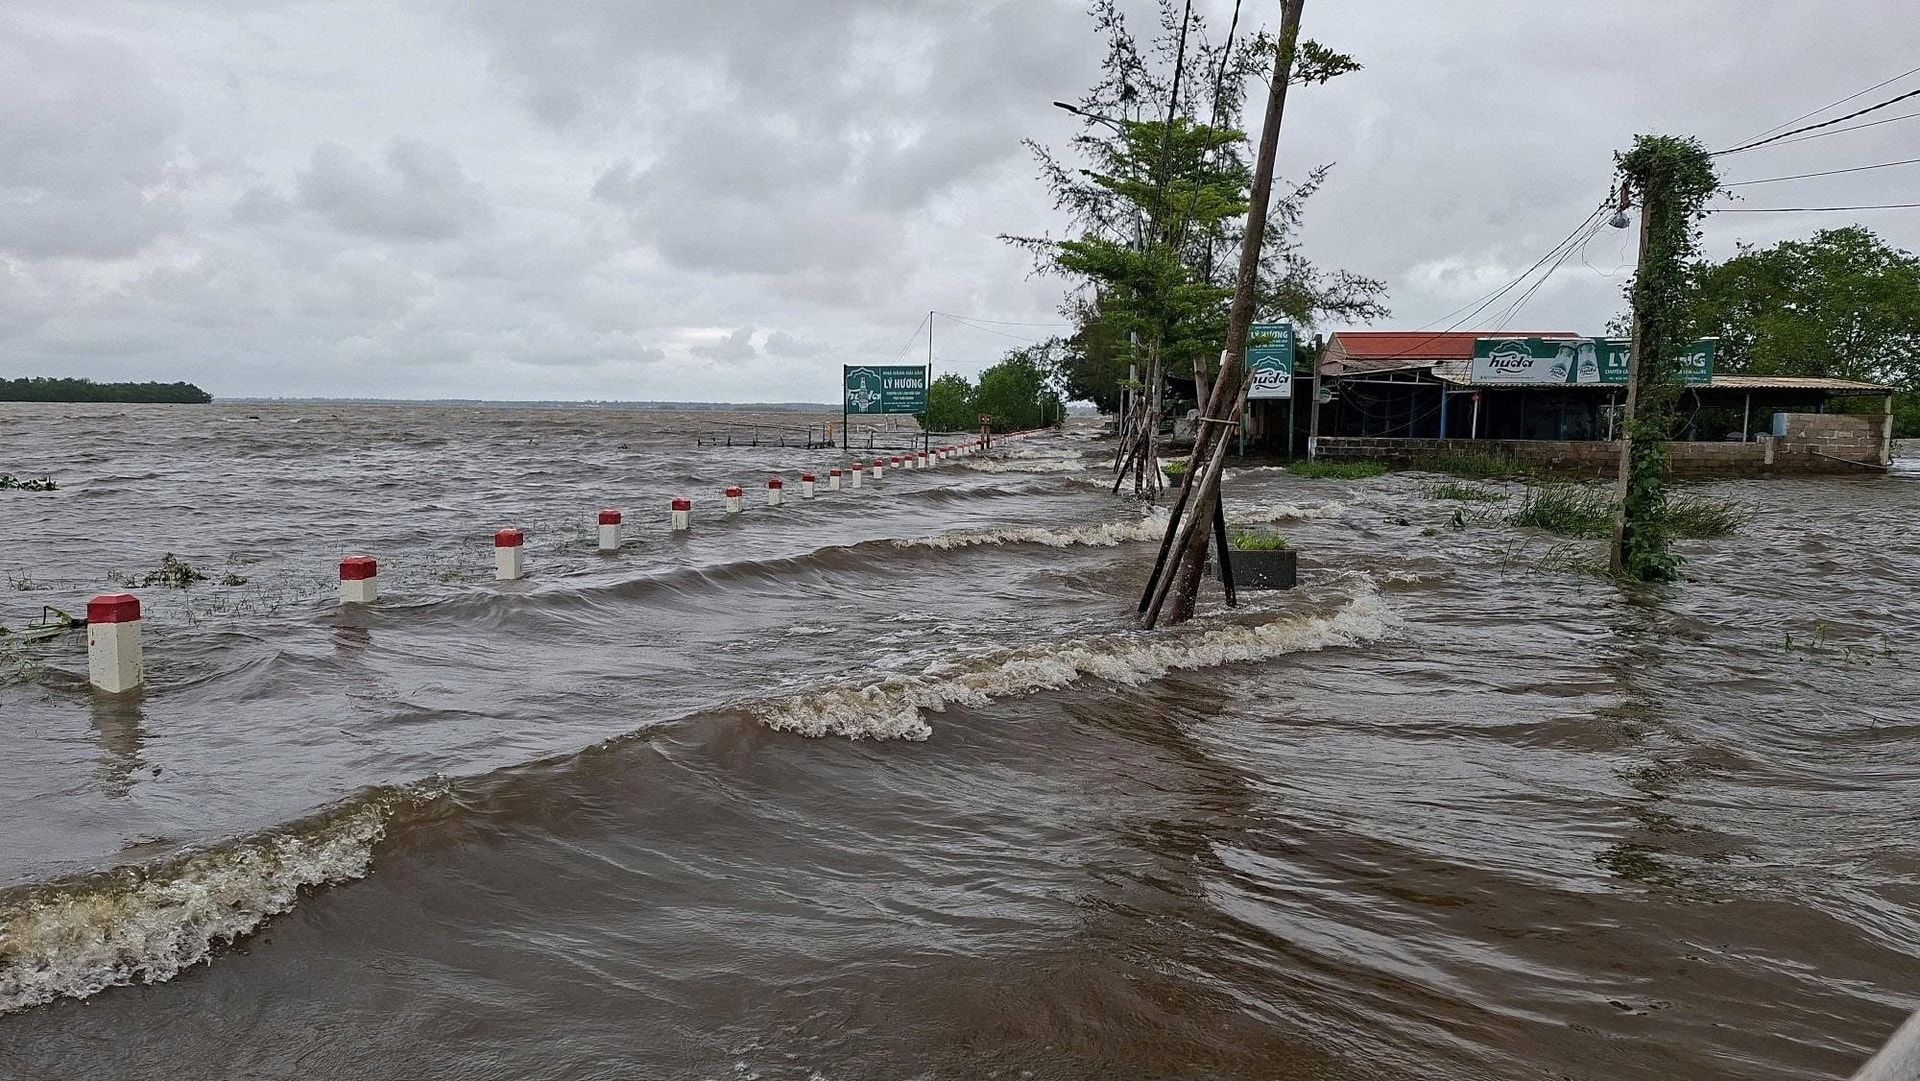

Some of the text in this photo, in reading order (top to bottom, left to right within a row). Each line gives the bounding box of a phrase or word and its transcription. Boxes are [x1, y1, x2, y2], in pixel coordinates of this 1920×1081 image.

[1488, 353, 1534, 368] huda
[883, 377, 923, 389] LÝ HƯƠNG
